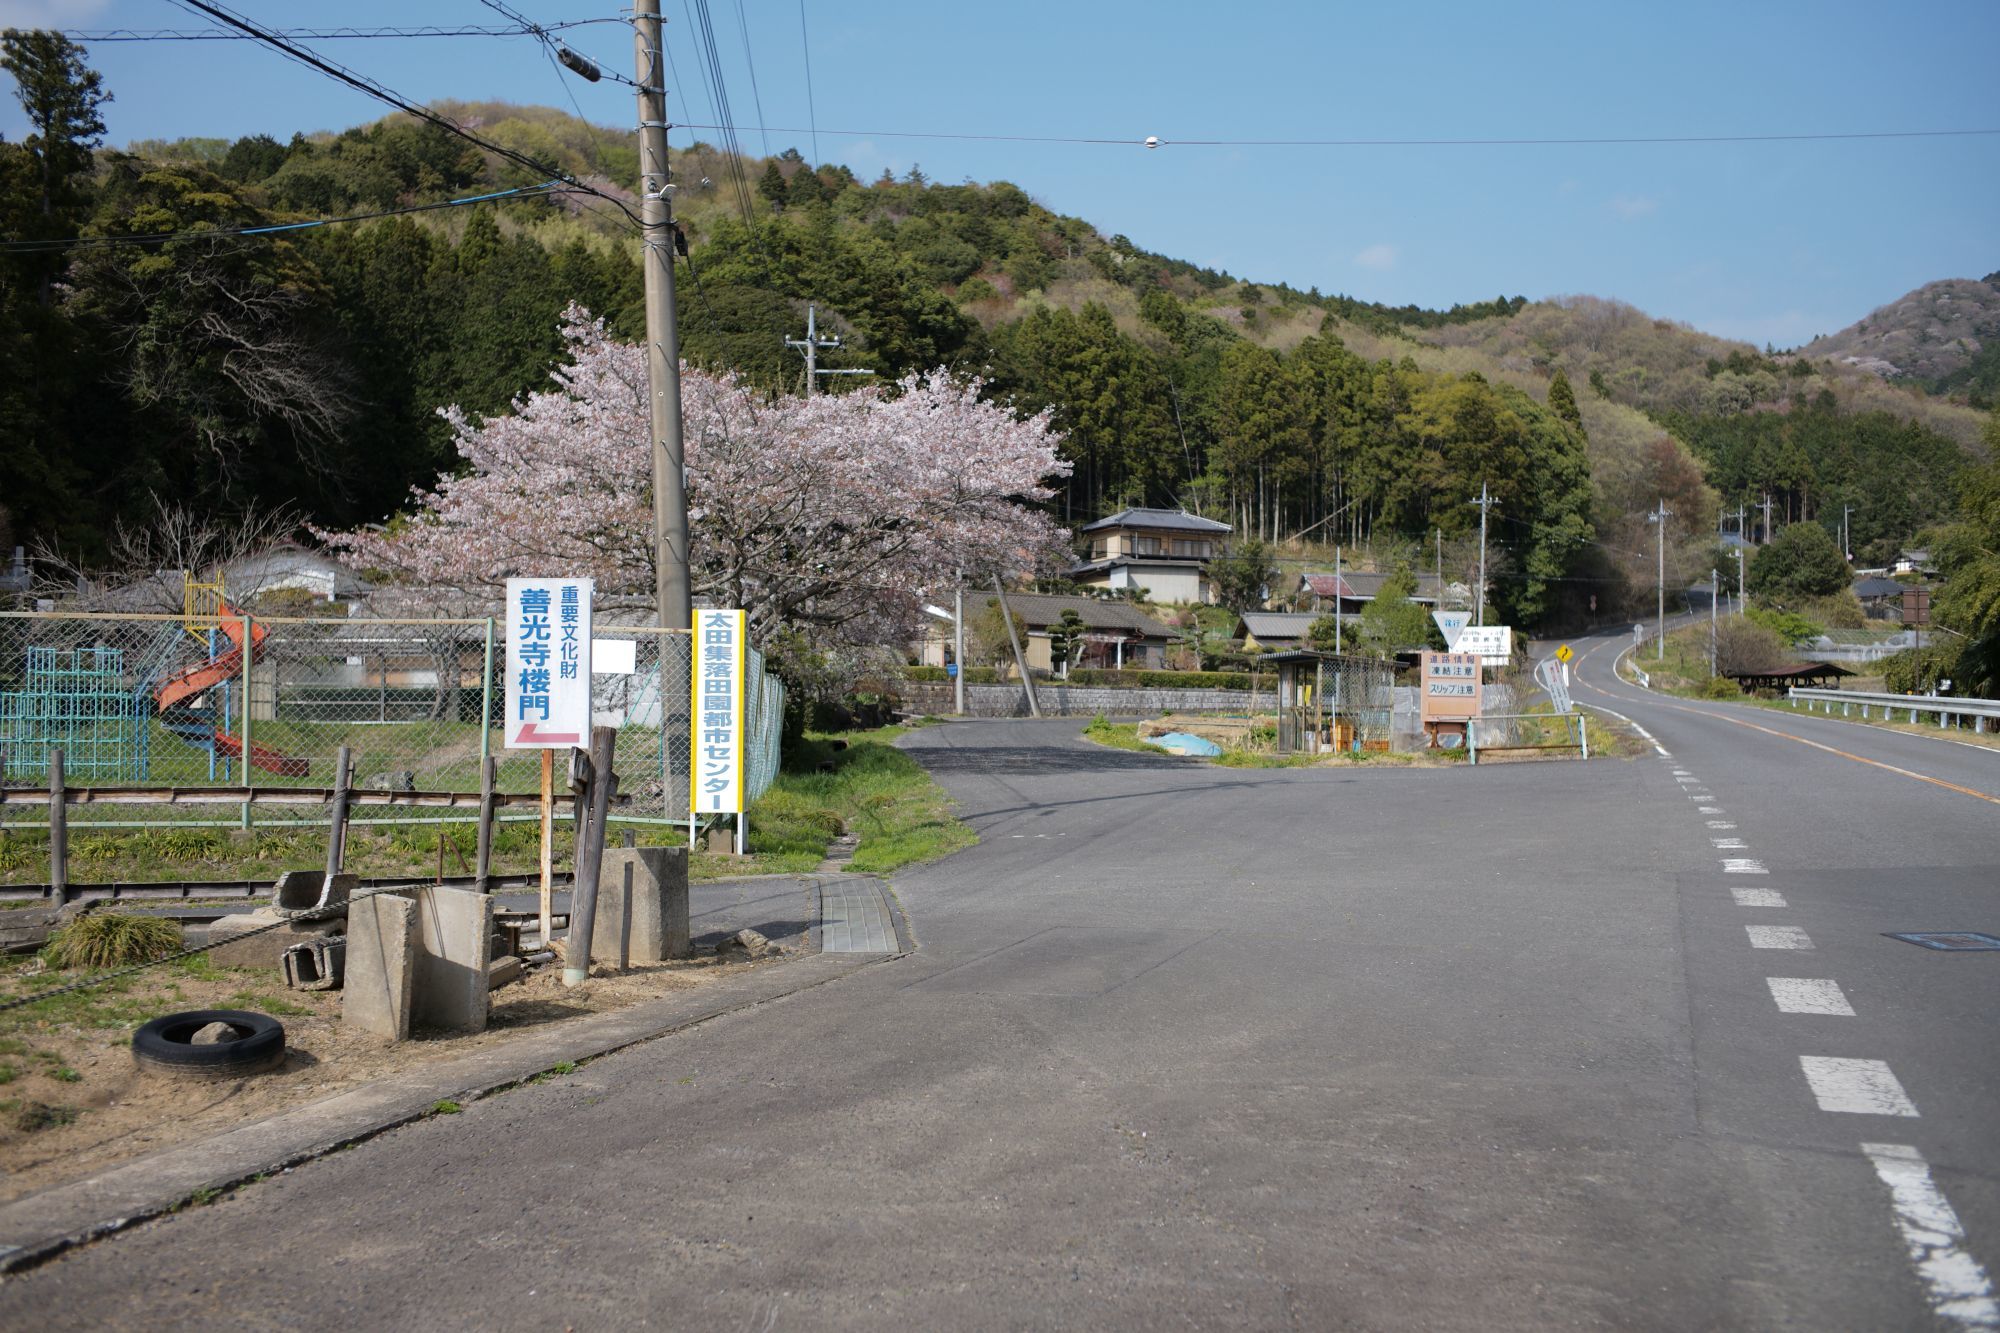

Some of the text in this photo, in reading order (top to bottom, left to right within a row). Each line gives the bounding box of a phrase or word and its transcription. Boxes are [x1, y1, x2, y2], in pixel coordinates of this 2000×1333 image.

[519, 588, 551, 721] 善光寺楼門
[560, 585, 579, 679] 重要文化財
[1430, 655, 1475, 664] 道路情報
[1432, 666, 1473, 676] 凍結注意
[703, 612, 733, 810] 太田集落田園都市センター
[1430, 684, 1474, 694] スリップ注意
